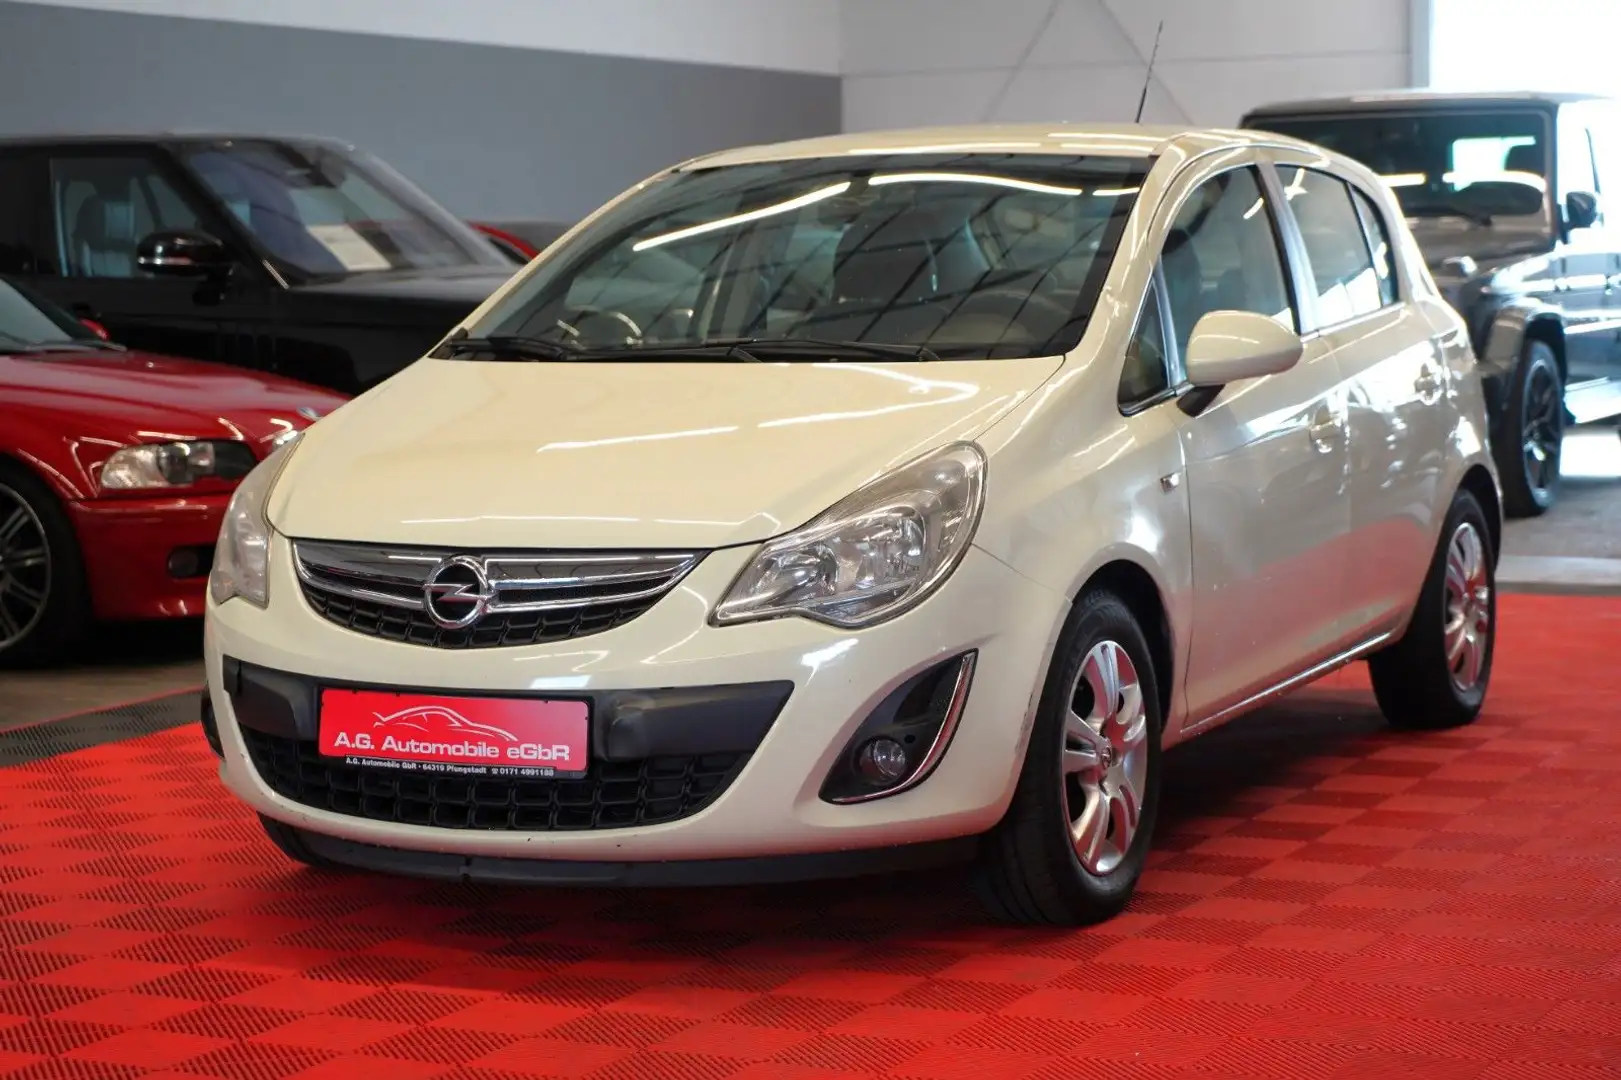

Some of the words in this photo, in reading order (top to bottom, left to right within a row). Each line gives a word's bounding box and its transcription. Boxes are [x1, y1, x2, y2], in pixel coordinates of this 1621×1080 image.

[333, 731, 374, 750] A.G.
[381, 735, 500, 759] Automobile
[506, 743, 570, 761] eGbR
[362, 758, 400, 769] Automobile
[402, 761, 417, 770] GbR
[422, 764, 445, 772] 64319
[446, 764, 487, 775] Pfungstadt
[499, 767, 518, 775] 0171
